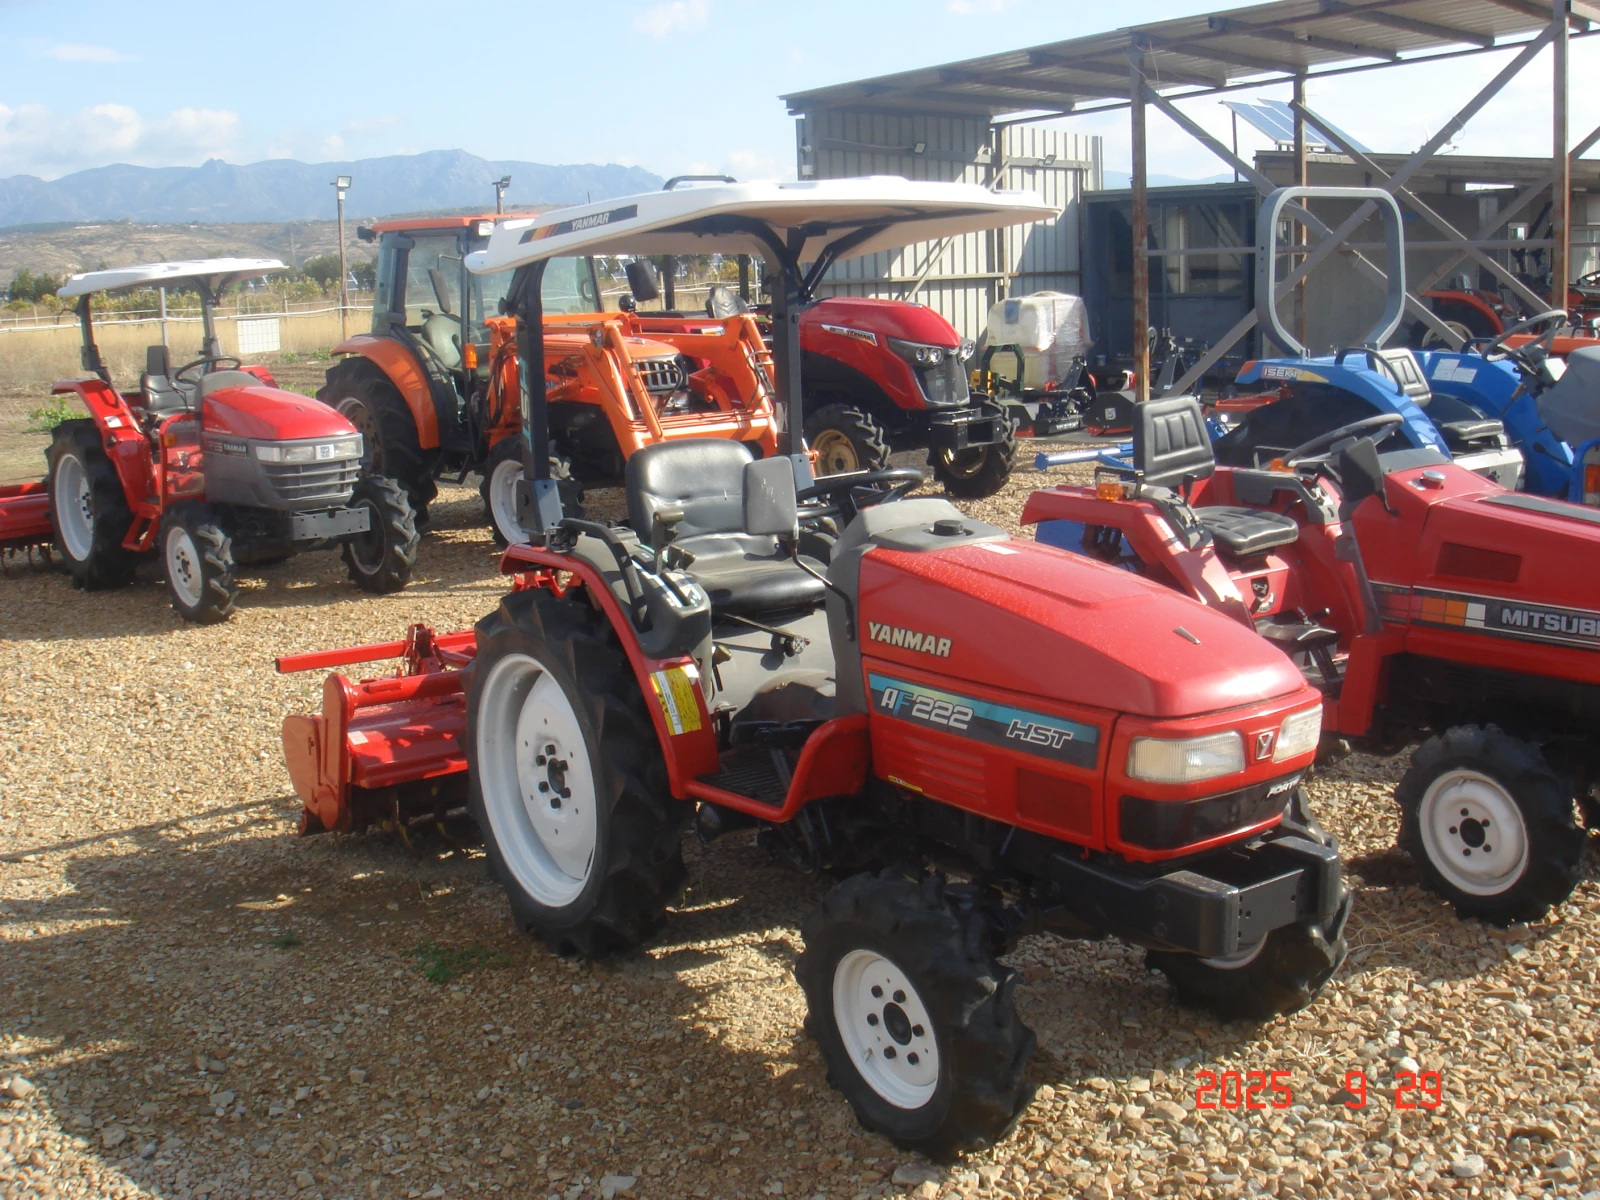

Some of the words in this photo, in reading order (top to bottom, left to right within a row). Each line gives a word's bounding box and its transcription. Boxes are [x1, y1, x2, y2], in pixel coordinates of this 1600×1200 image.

[571, 212, 610, 231] YANMAR
[1264, 367, 1297, 378] ISEKI
[868, 620, 952, 658] YANMAR
[1006, 719, 1084, 749] HST
